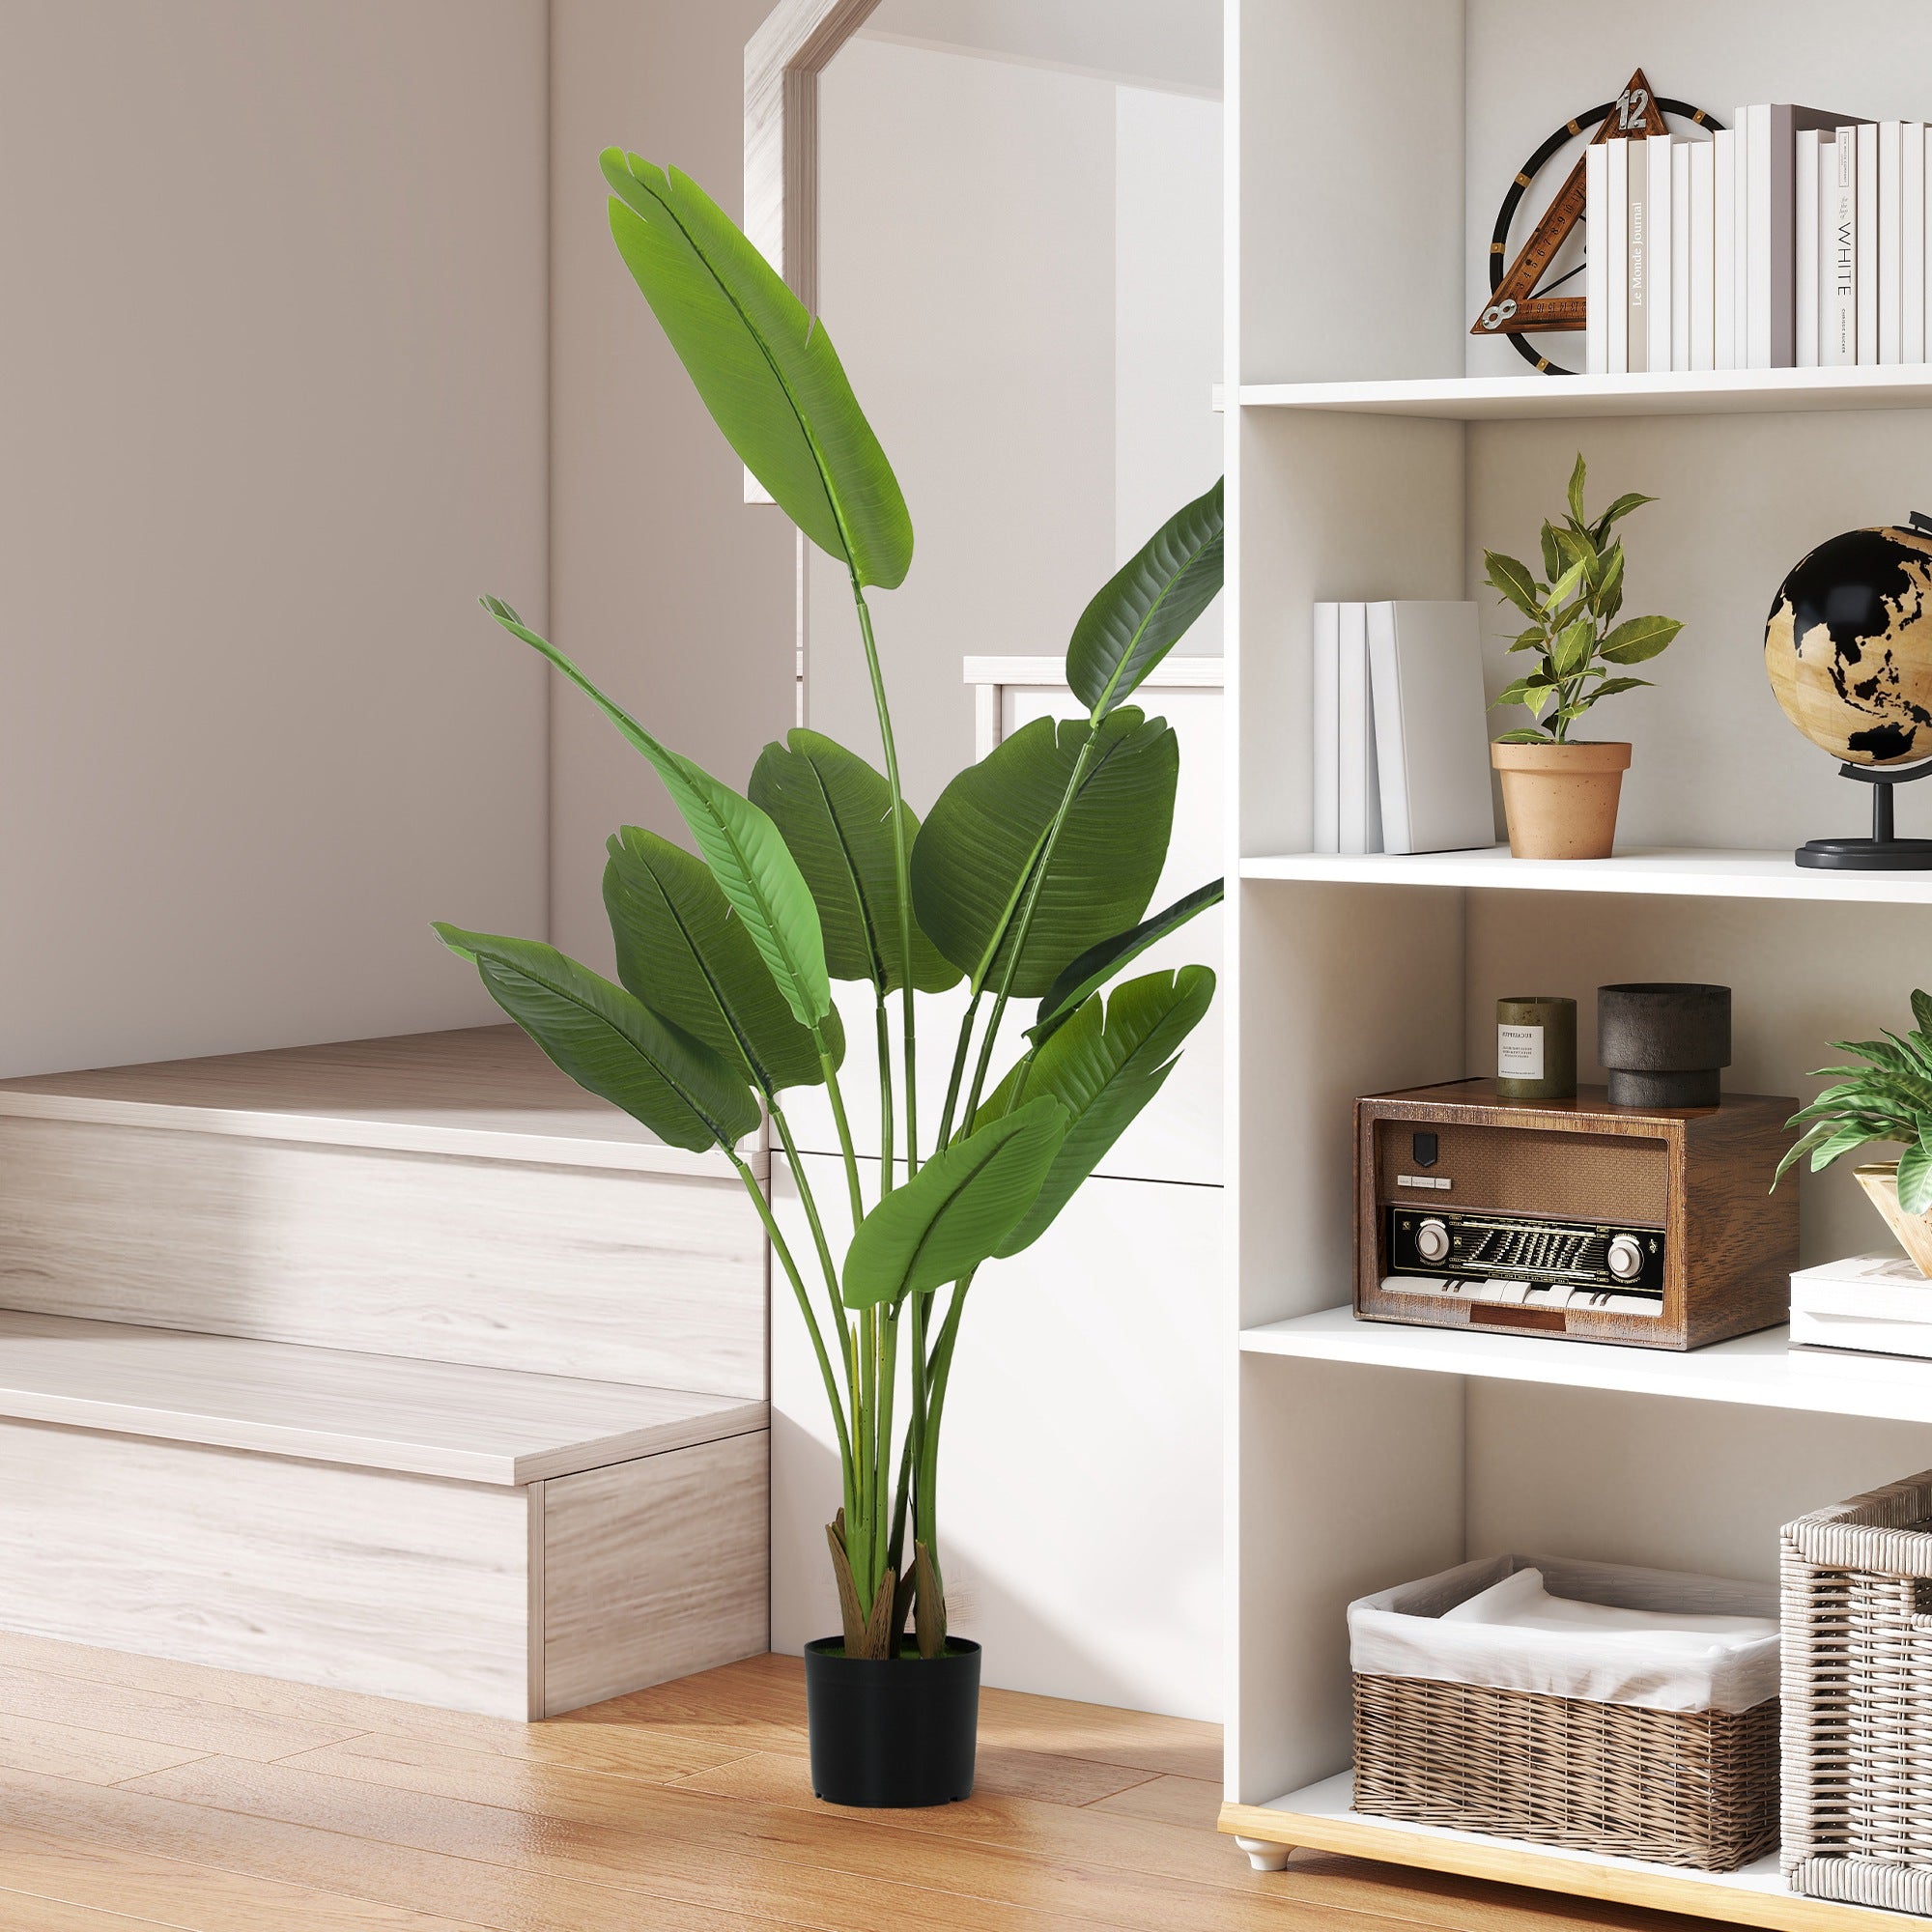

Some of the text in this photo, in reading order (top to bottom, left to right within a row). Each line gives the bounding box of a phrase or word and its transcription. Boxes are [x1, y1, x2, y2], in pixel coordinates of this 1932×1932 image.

[1616, 88, 1649, 130] 12
[1537, 248, 1546, 257] 6
[1543, 238, 1551, 246] 7
[1550, 227, 1559, 236] 8
[1557, 215, 1566, 225] 9
[1632, 202, 1643, 306] Le Monde Journal
[1837, 222, 1852, 296] WHITE
[1482, 298, 1518, 330] 8
